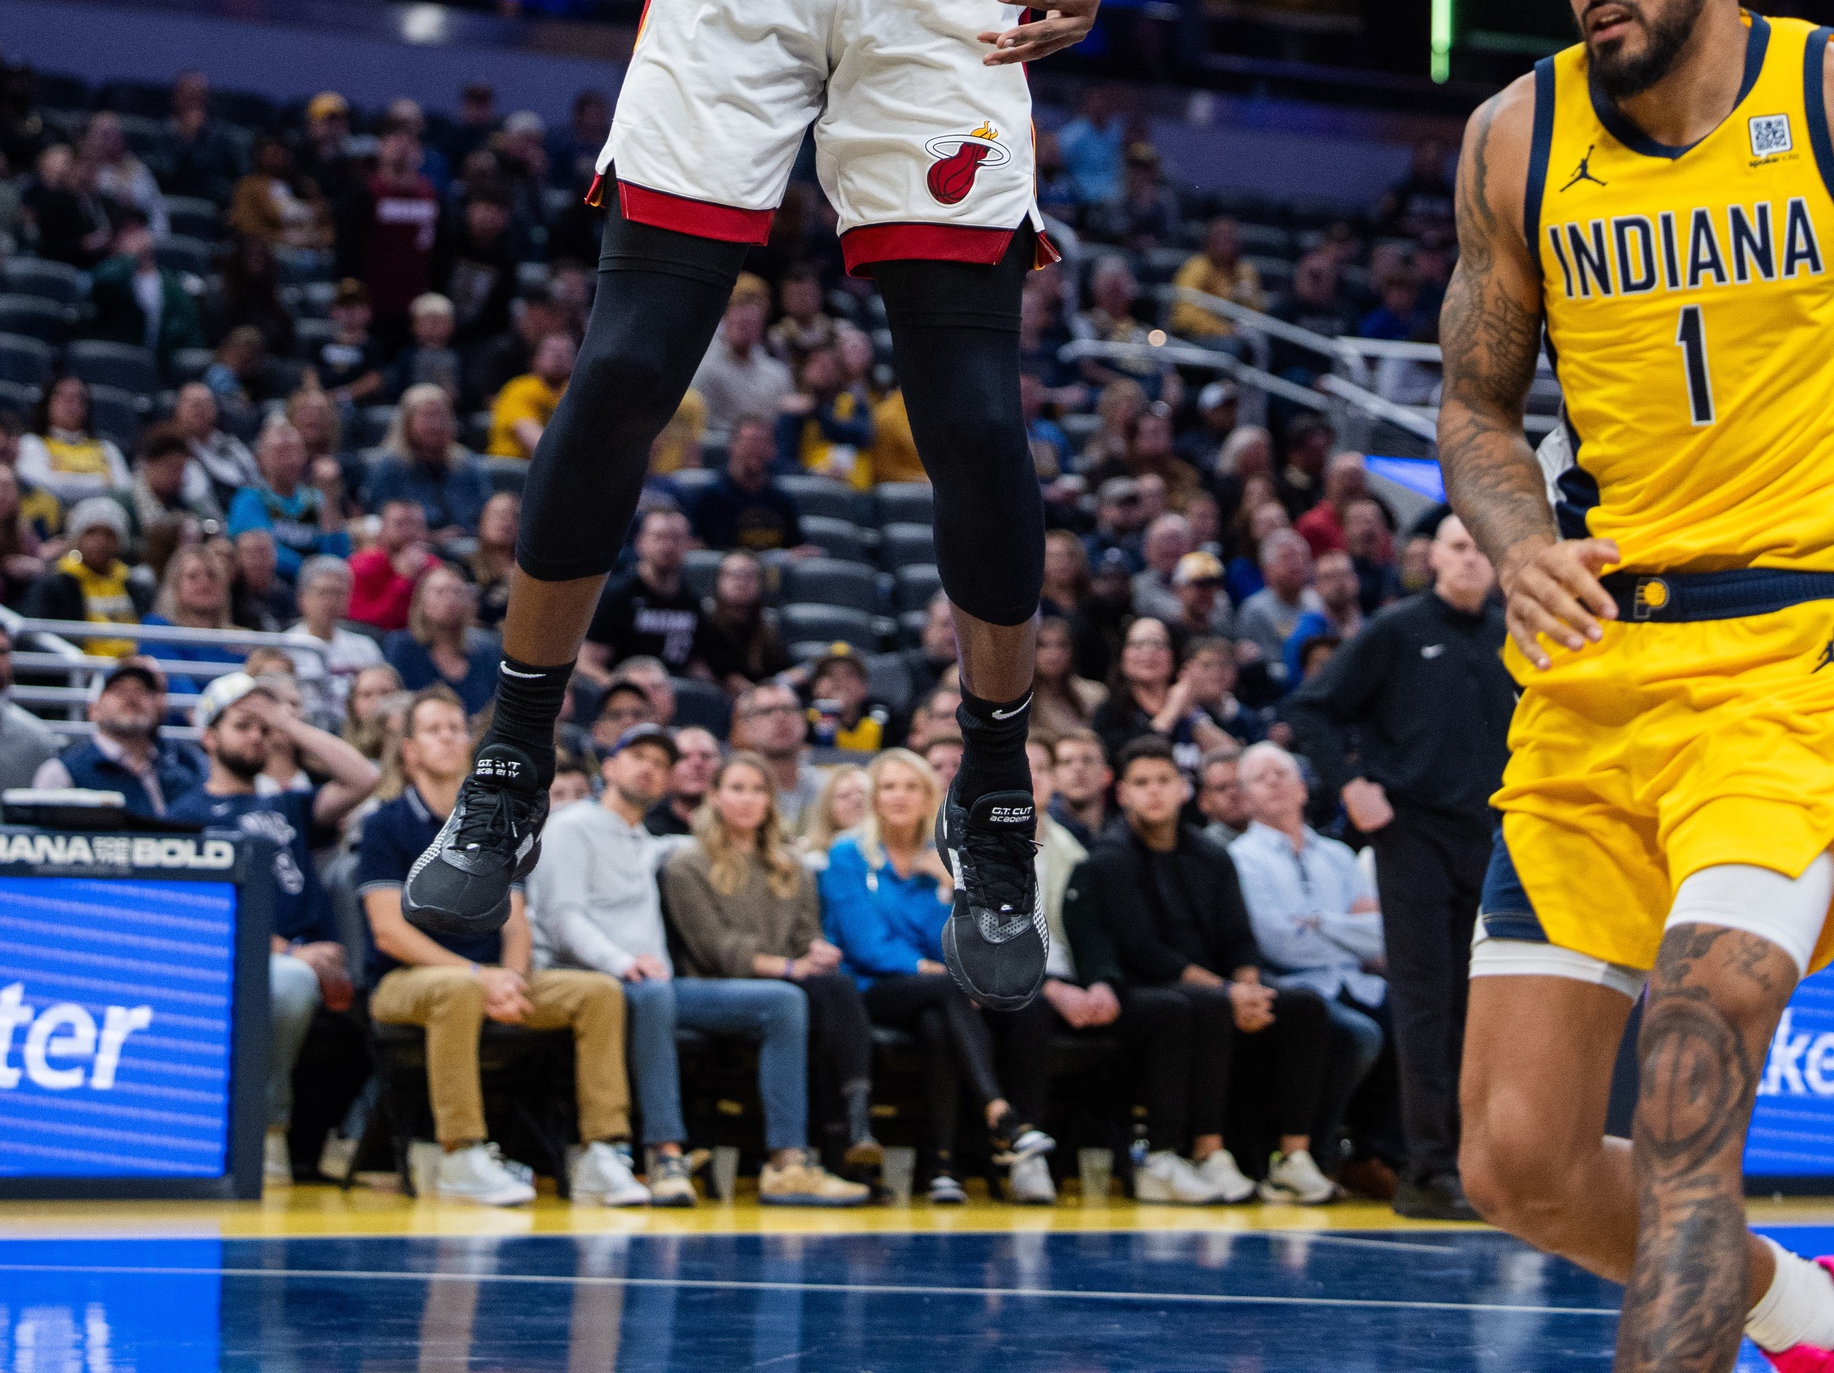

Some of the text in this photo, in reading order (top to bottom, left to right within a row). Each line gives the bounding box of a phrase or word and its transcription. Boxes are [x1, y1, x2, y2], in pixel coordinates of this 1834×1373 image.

[1548, 196, 1826, 300] INDIANA
[1675, 303, 1716, 427] 1
[132, 836, 235, 870] BOLD
[1012, 806, 1033, 815] CUT
[1757, 1006, 1834, 1096] ke
